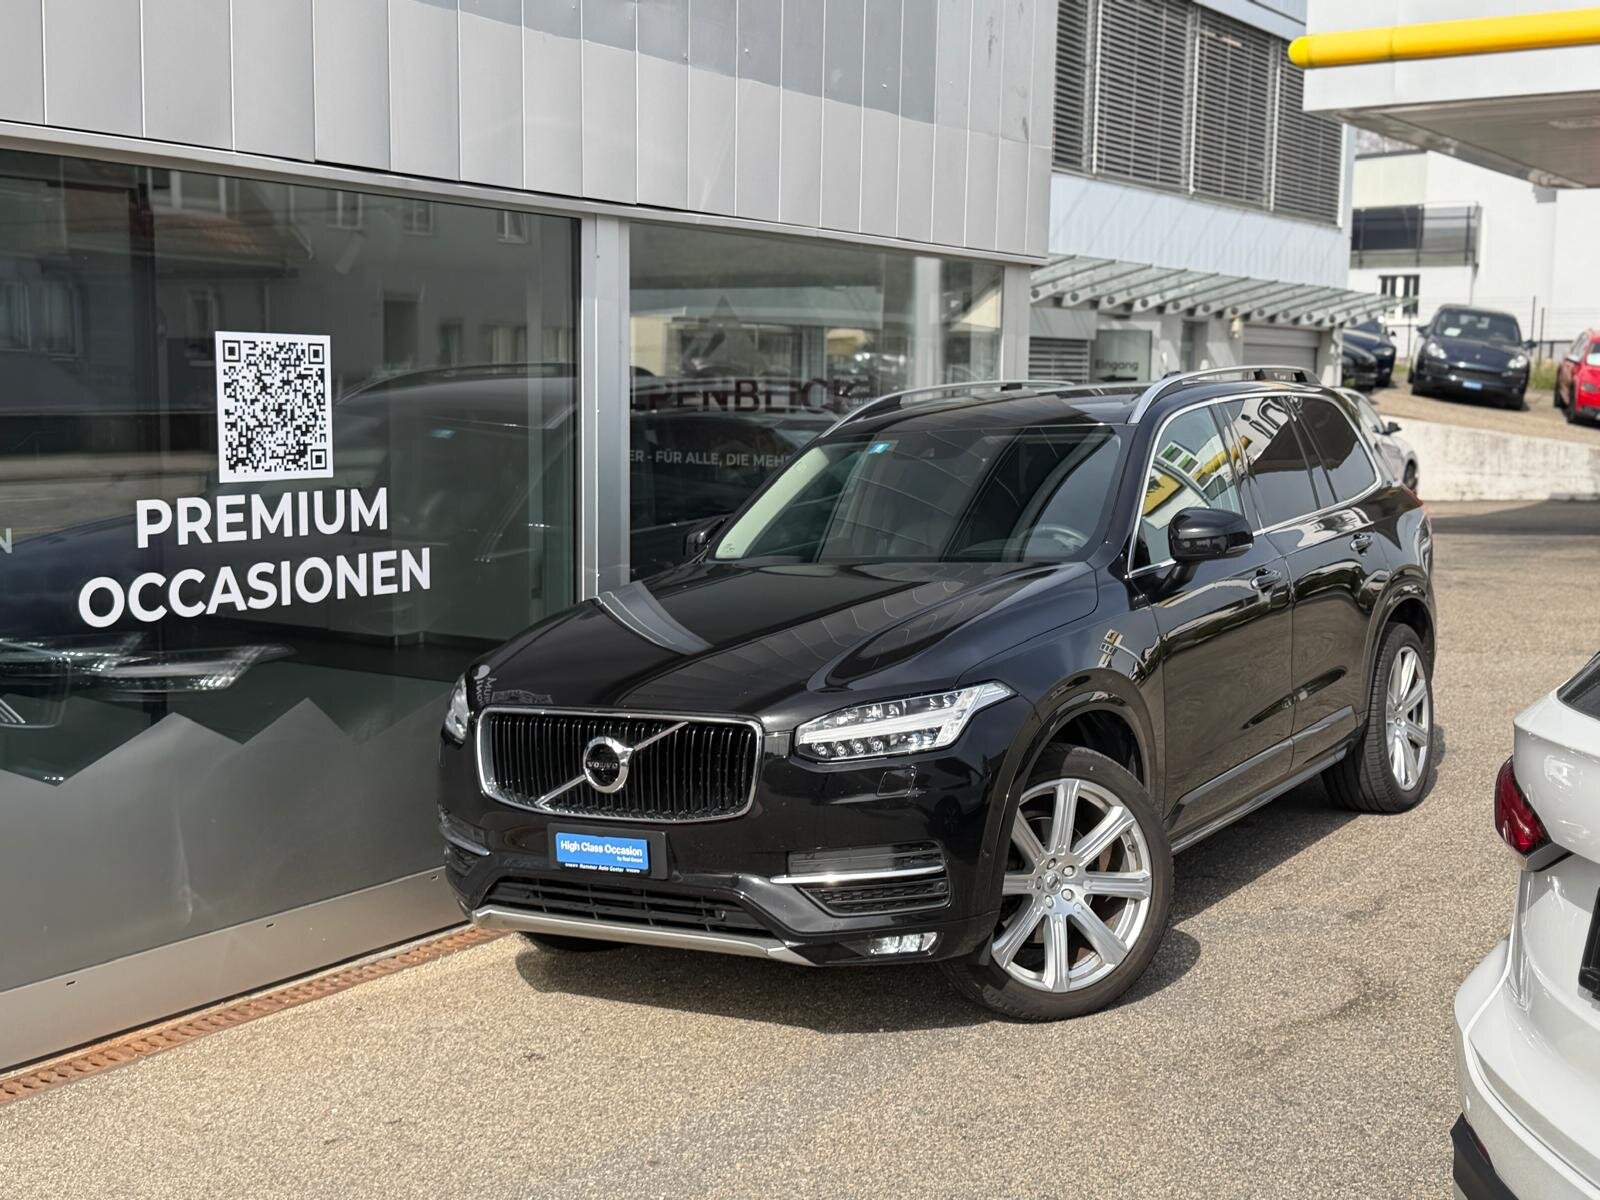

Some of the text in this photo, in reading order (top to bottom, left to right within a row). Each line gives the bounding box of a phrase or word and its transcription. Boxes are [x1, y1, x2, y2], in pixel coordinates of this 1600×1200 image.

[1095, 359, 1139, 373] Eingang
[655, 448, 682, 464] FÜR
[685, 451, 722, 467] ALLE,
[726, 453, 749, 466] DIE
[136, 487, 389, 549] PREMIUM
[78, 547, 432, 628] OCCASIONEN
[587, 761, 618, 769] VOLVO
[560, 840, 643, 857] High Class Occasion
